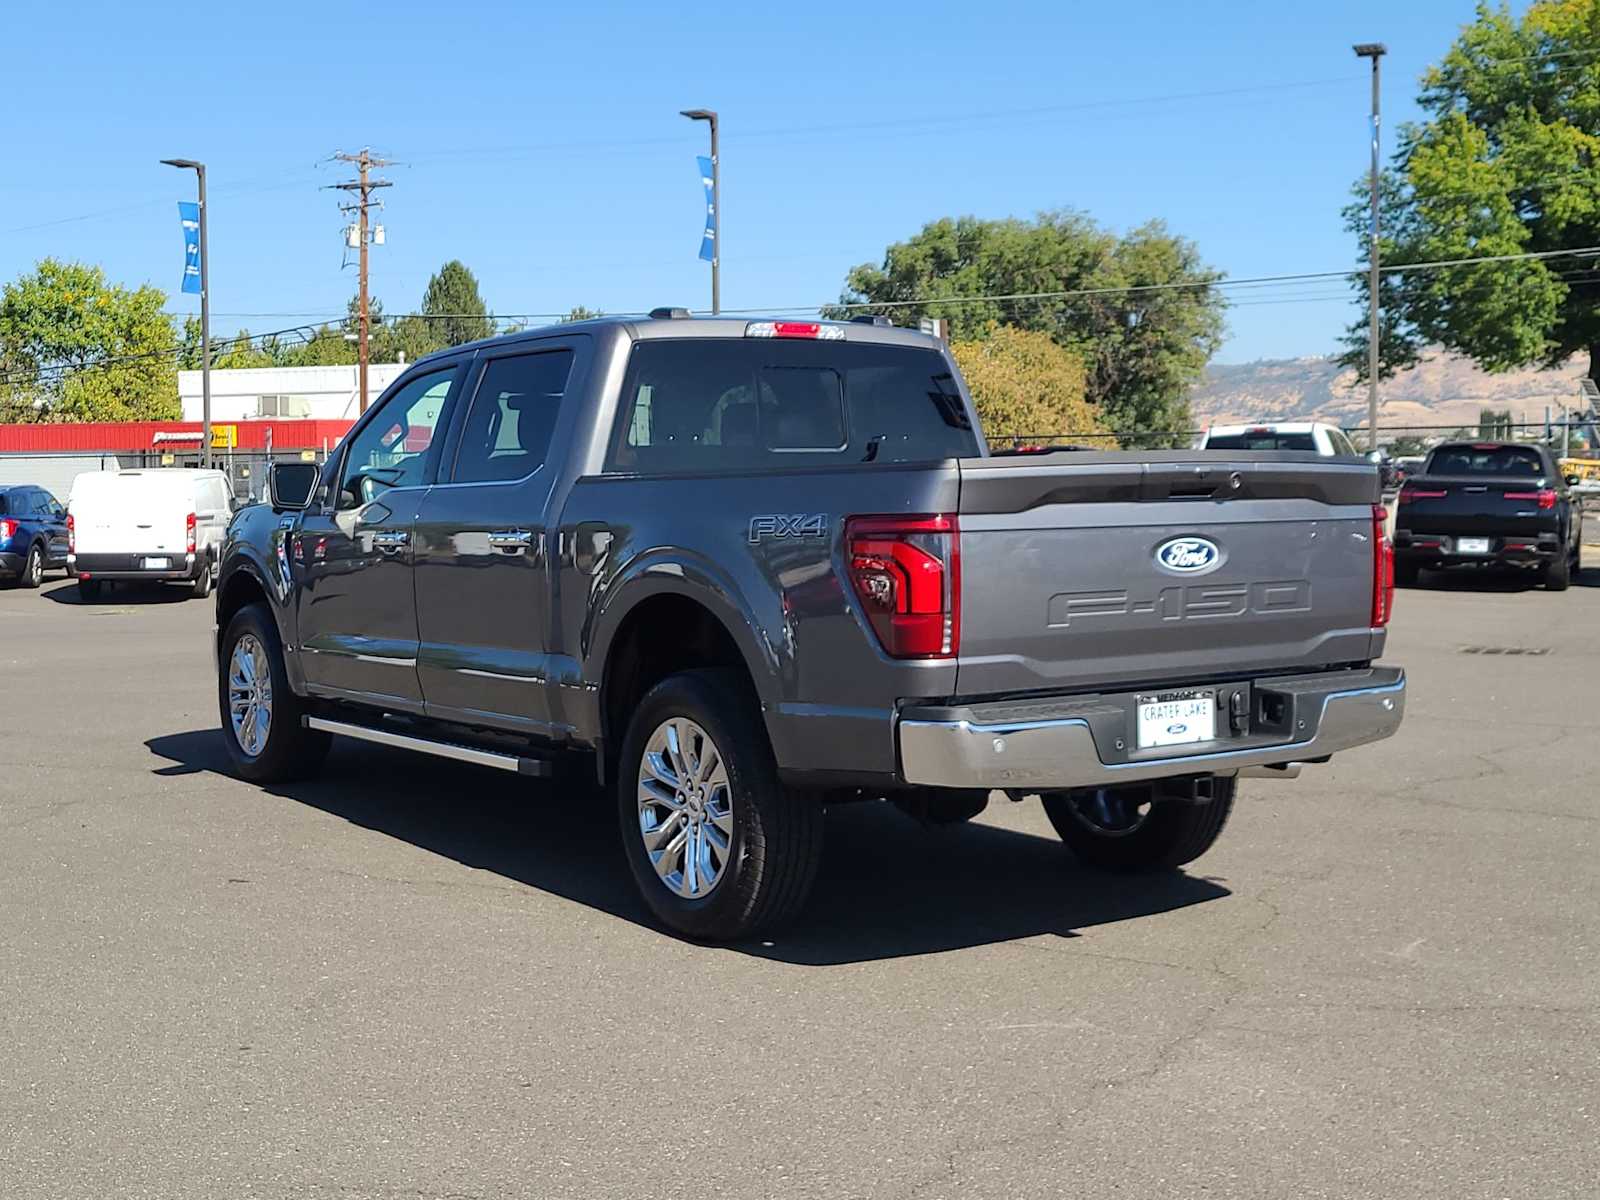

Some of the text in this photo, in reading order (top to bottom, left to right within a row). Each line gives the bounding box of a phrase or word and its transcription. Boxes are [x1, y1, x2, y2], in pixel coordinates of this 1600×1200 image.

[749, 513, 827, 544] FX4
[1164, 541, 1211, 567] Ford
[1047, 579, 1312, 629] F-150
[1144, 704, 1180, 721] CRATER
